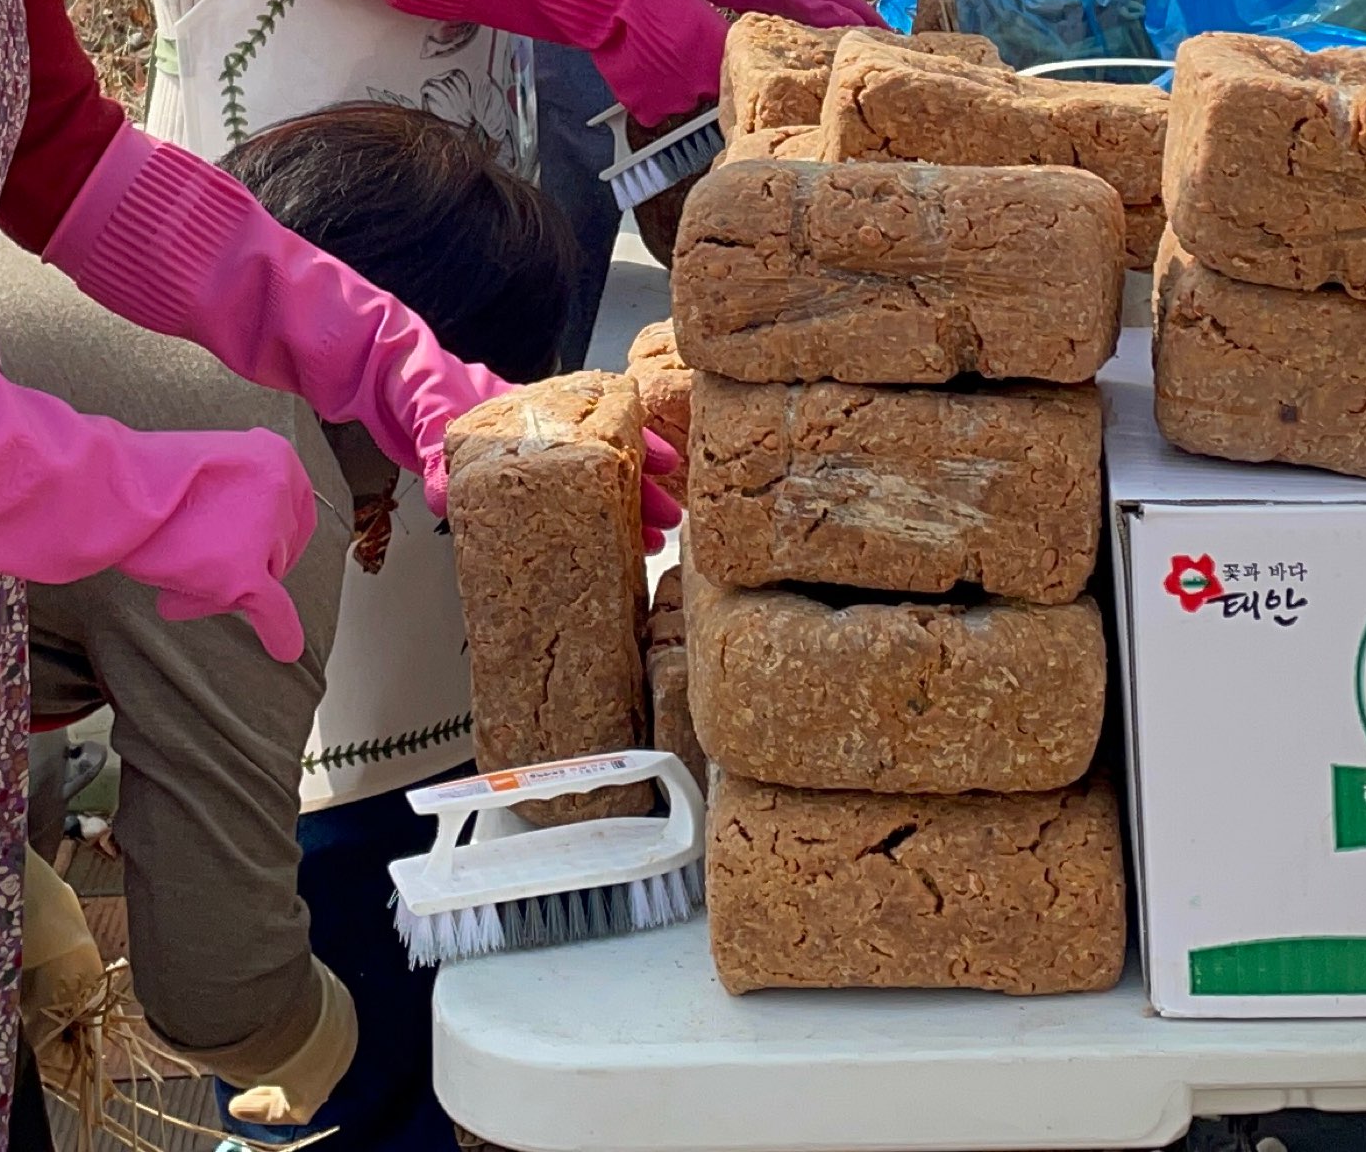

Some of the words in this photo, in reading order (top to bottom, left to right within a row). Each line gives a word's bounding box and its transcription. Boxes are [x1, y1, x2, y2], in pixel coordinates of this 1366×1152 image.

[1222, 562, 1261, 582] 꽃과
[1268, 561, 1308, 582] 바다
[1204, 587, 1309, 627] 태안
